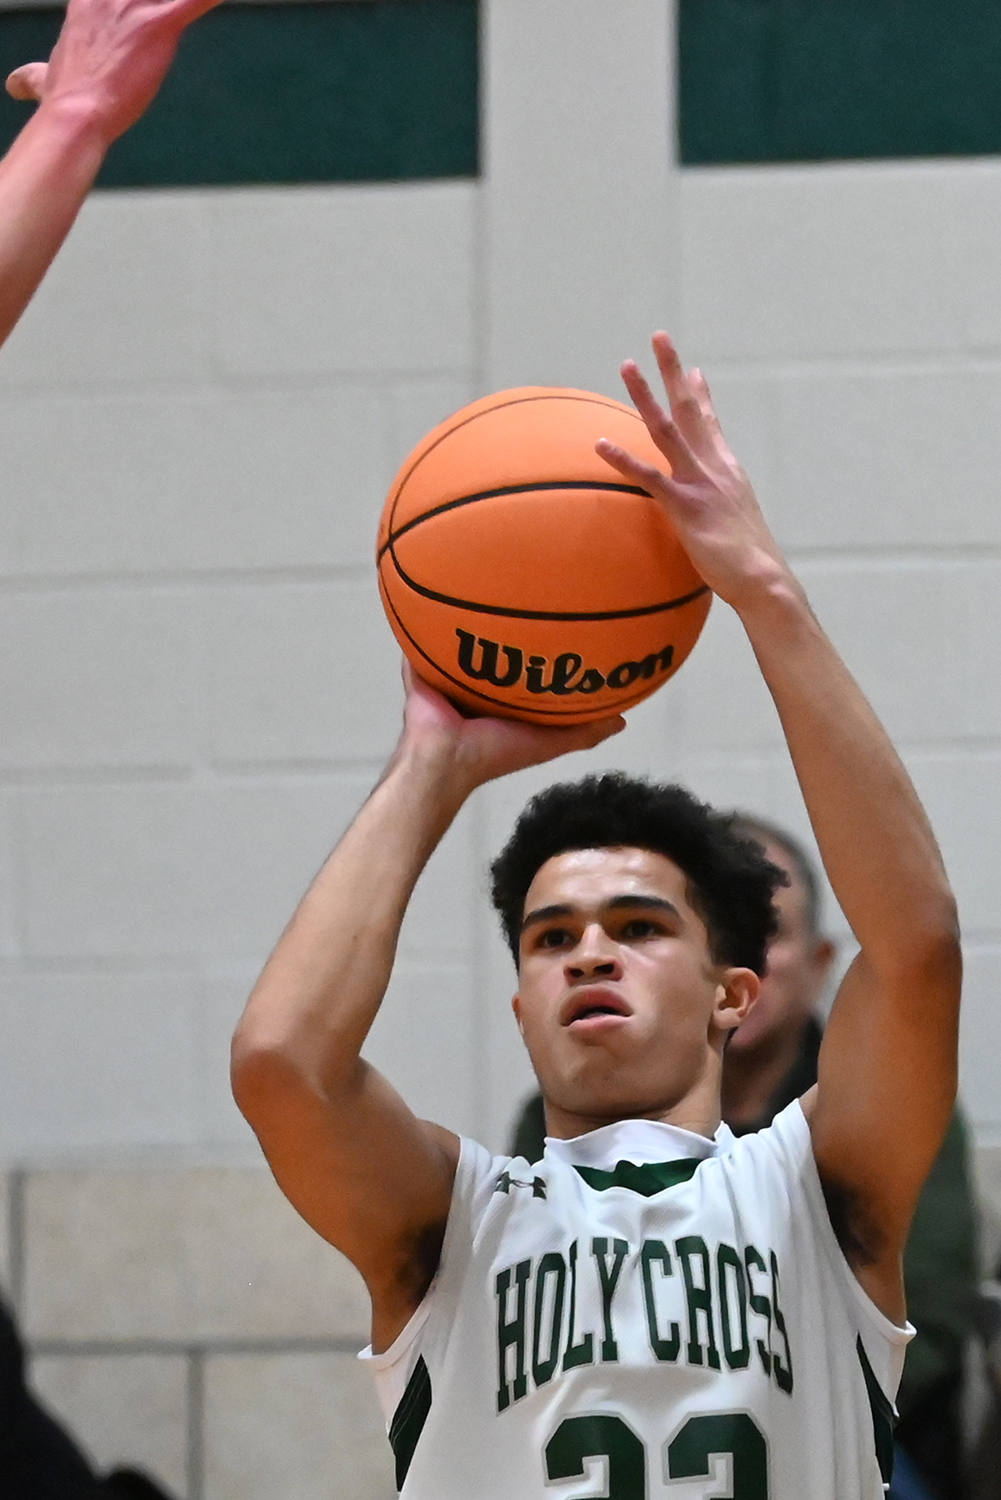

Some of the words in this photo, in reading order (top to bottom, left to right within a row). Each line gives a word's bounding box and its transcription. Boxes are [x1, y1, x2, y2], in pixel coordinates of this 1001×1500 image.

[455, 627, 675, 695] Wilson
[496, 1236, 629, 1415] HOLY
[640, 1235, 795, 1397] CROSS
